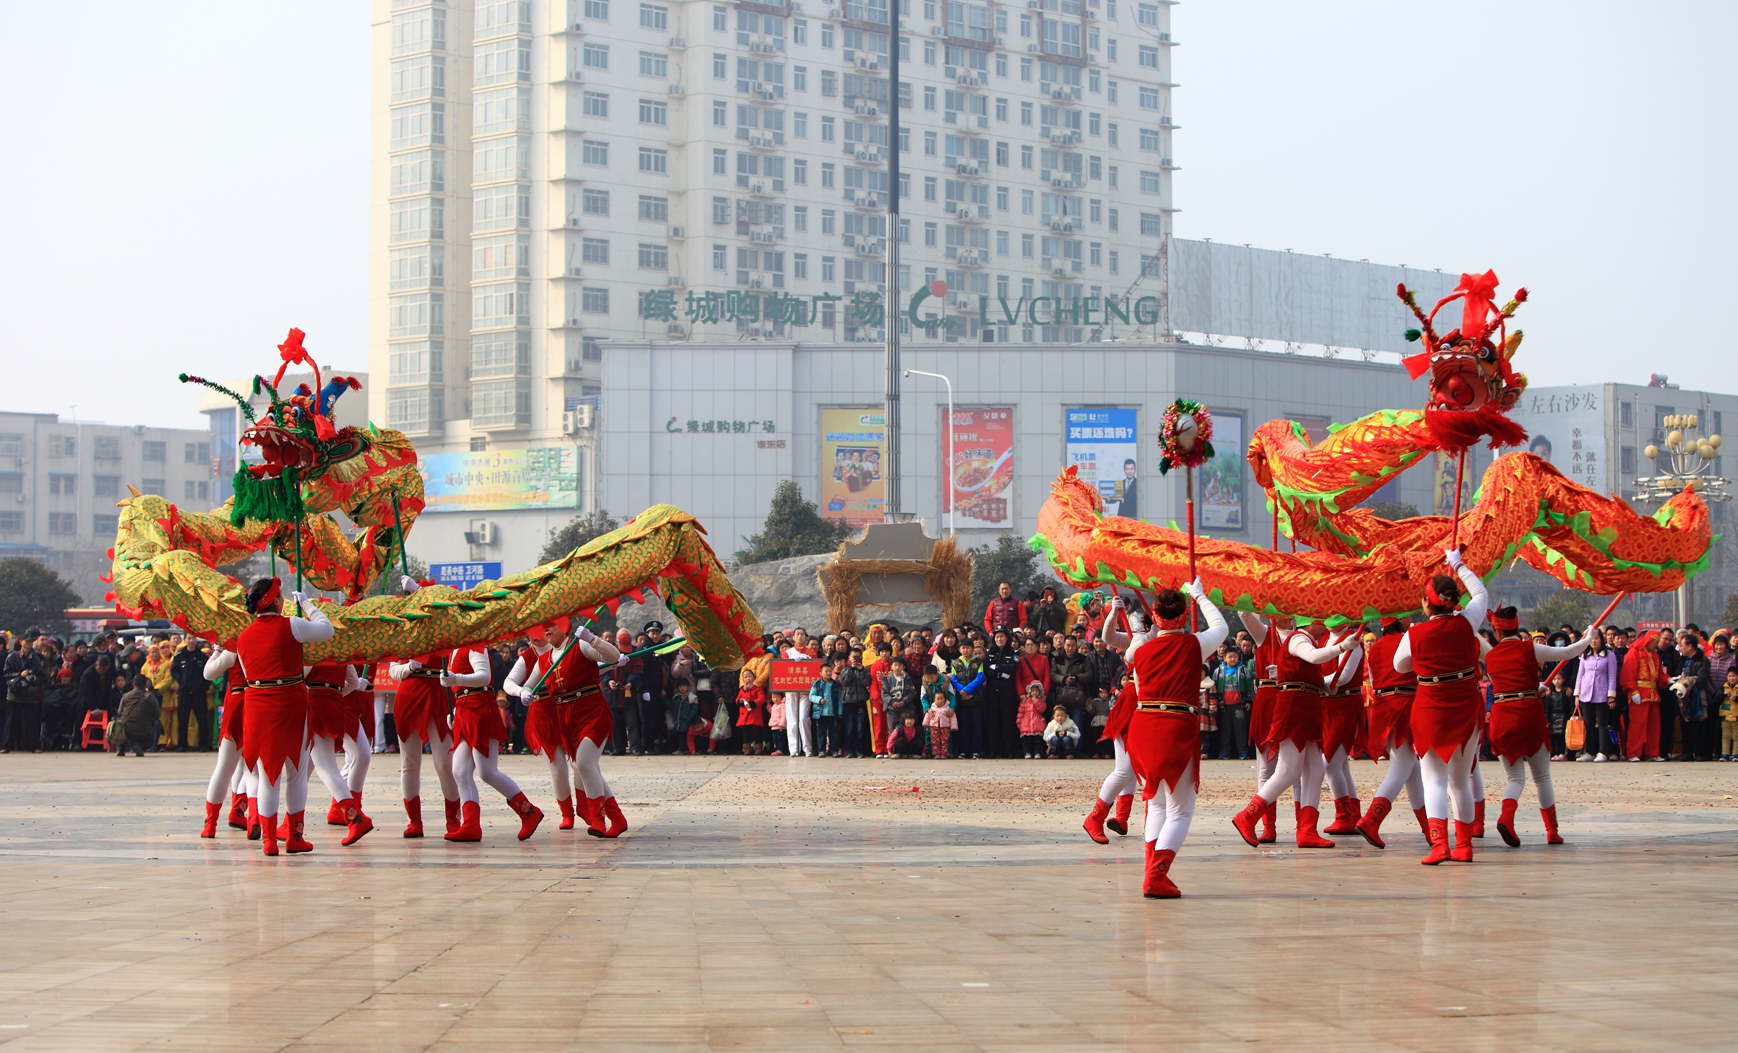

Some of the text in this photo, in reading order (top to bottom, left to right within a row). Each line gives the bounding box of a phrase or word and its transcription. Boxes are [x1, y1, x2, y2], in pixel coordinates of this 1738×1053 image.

[643, 289, 886, 327] 绿城购物广场
[980, 295, 1159, 326] LVCHENG
[1529, 392, 1598, 415] 左右沙发
[686, 420, 776, 433] 绿城购物广场
